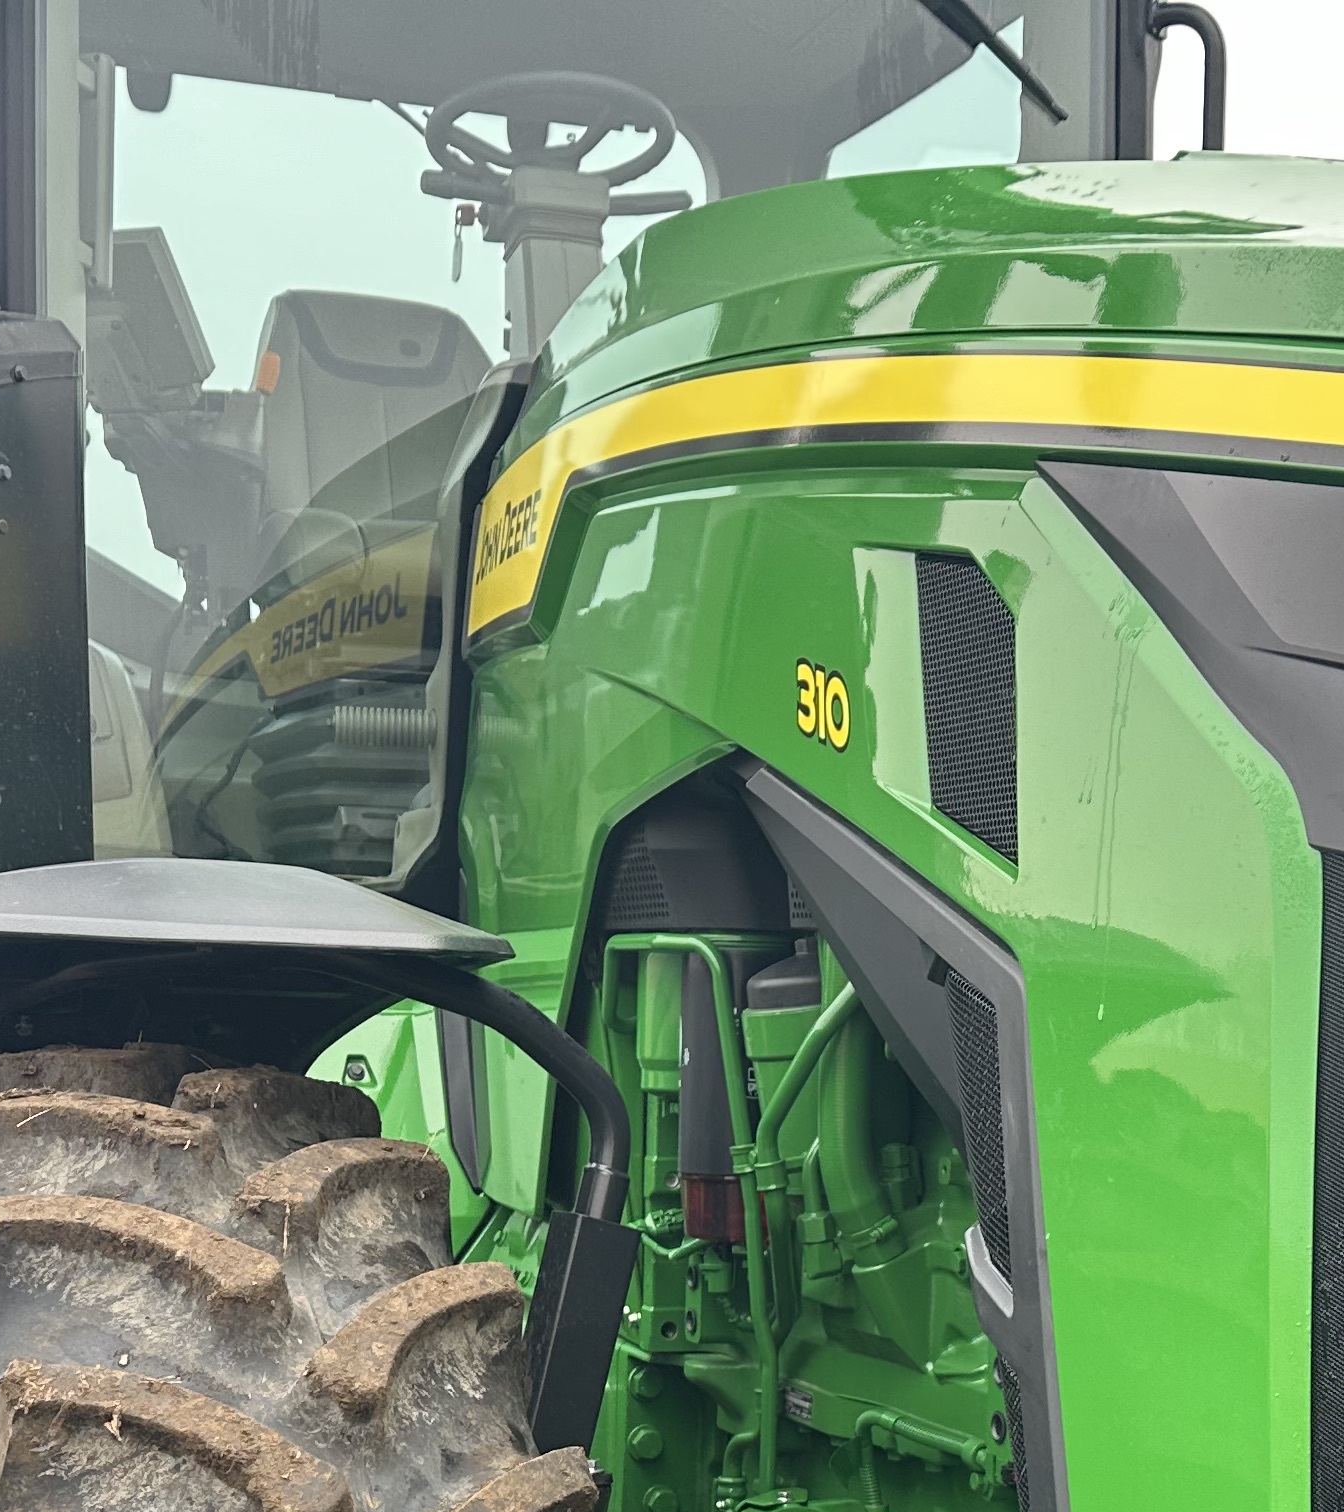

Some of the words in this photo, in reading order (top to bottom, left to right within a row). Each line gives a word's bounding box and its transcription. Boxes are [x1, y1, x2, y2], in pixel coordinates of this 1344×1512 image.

[476, 518, 503, 586] JOHN
[499, 488, 542, 566] DEERE
[797, 658, 851, 753] 310
